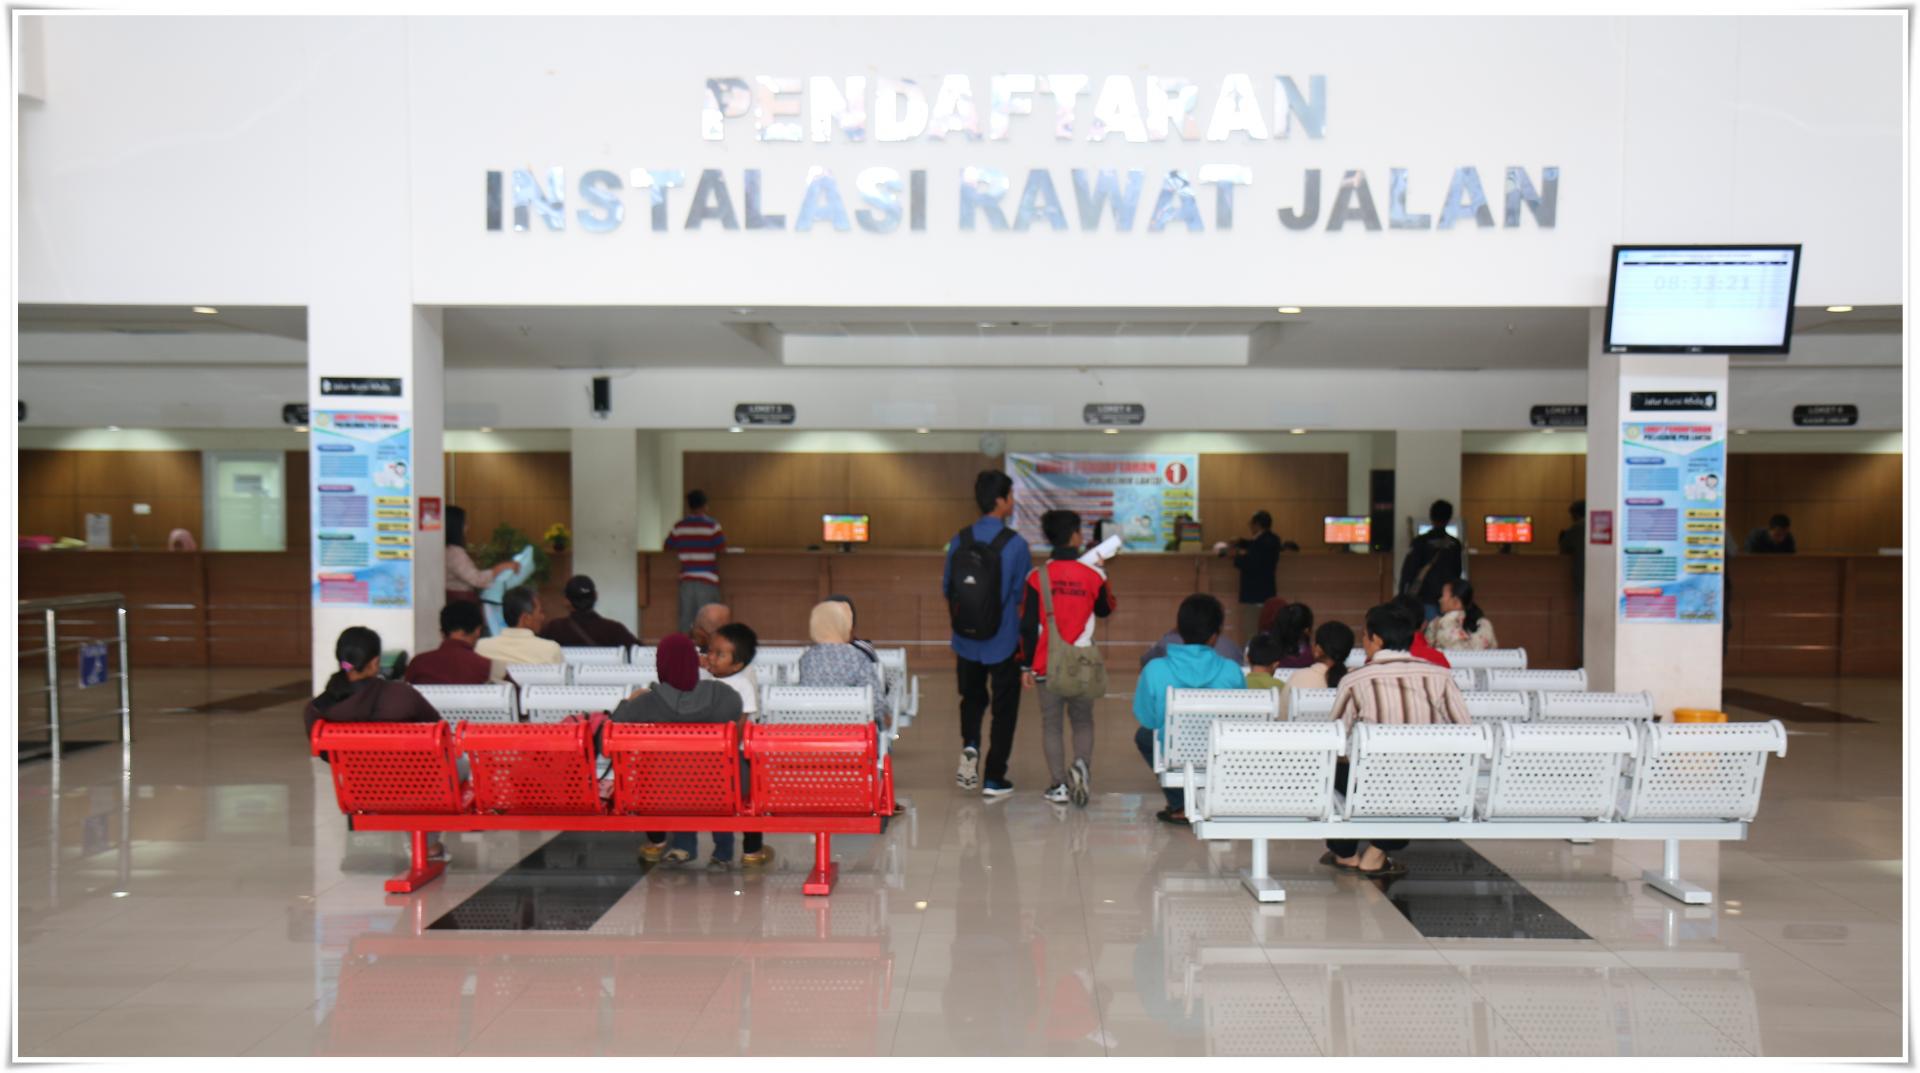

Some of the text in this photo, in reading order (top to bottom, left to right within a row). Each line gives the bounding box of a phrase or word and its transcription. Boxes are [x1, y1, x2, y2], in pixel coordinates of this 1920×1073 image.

[703, 73, 1328, 142] PENDAFTARAN
[486, 163, 1560, 232] INSTALASI RAWAT JALAN
[1171, 463, 1182, 484] 1
